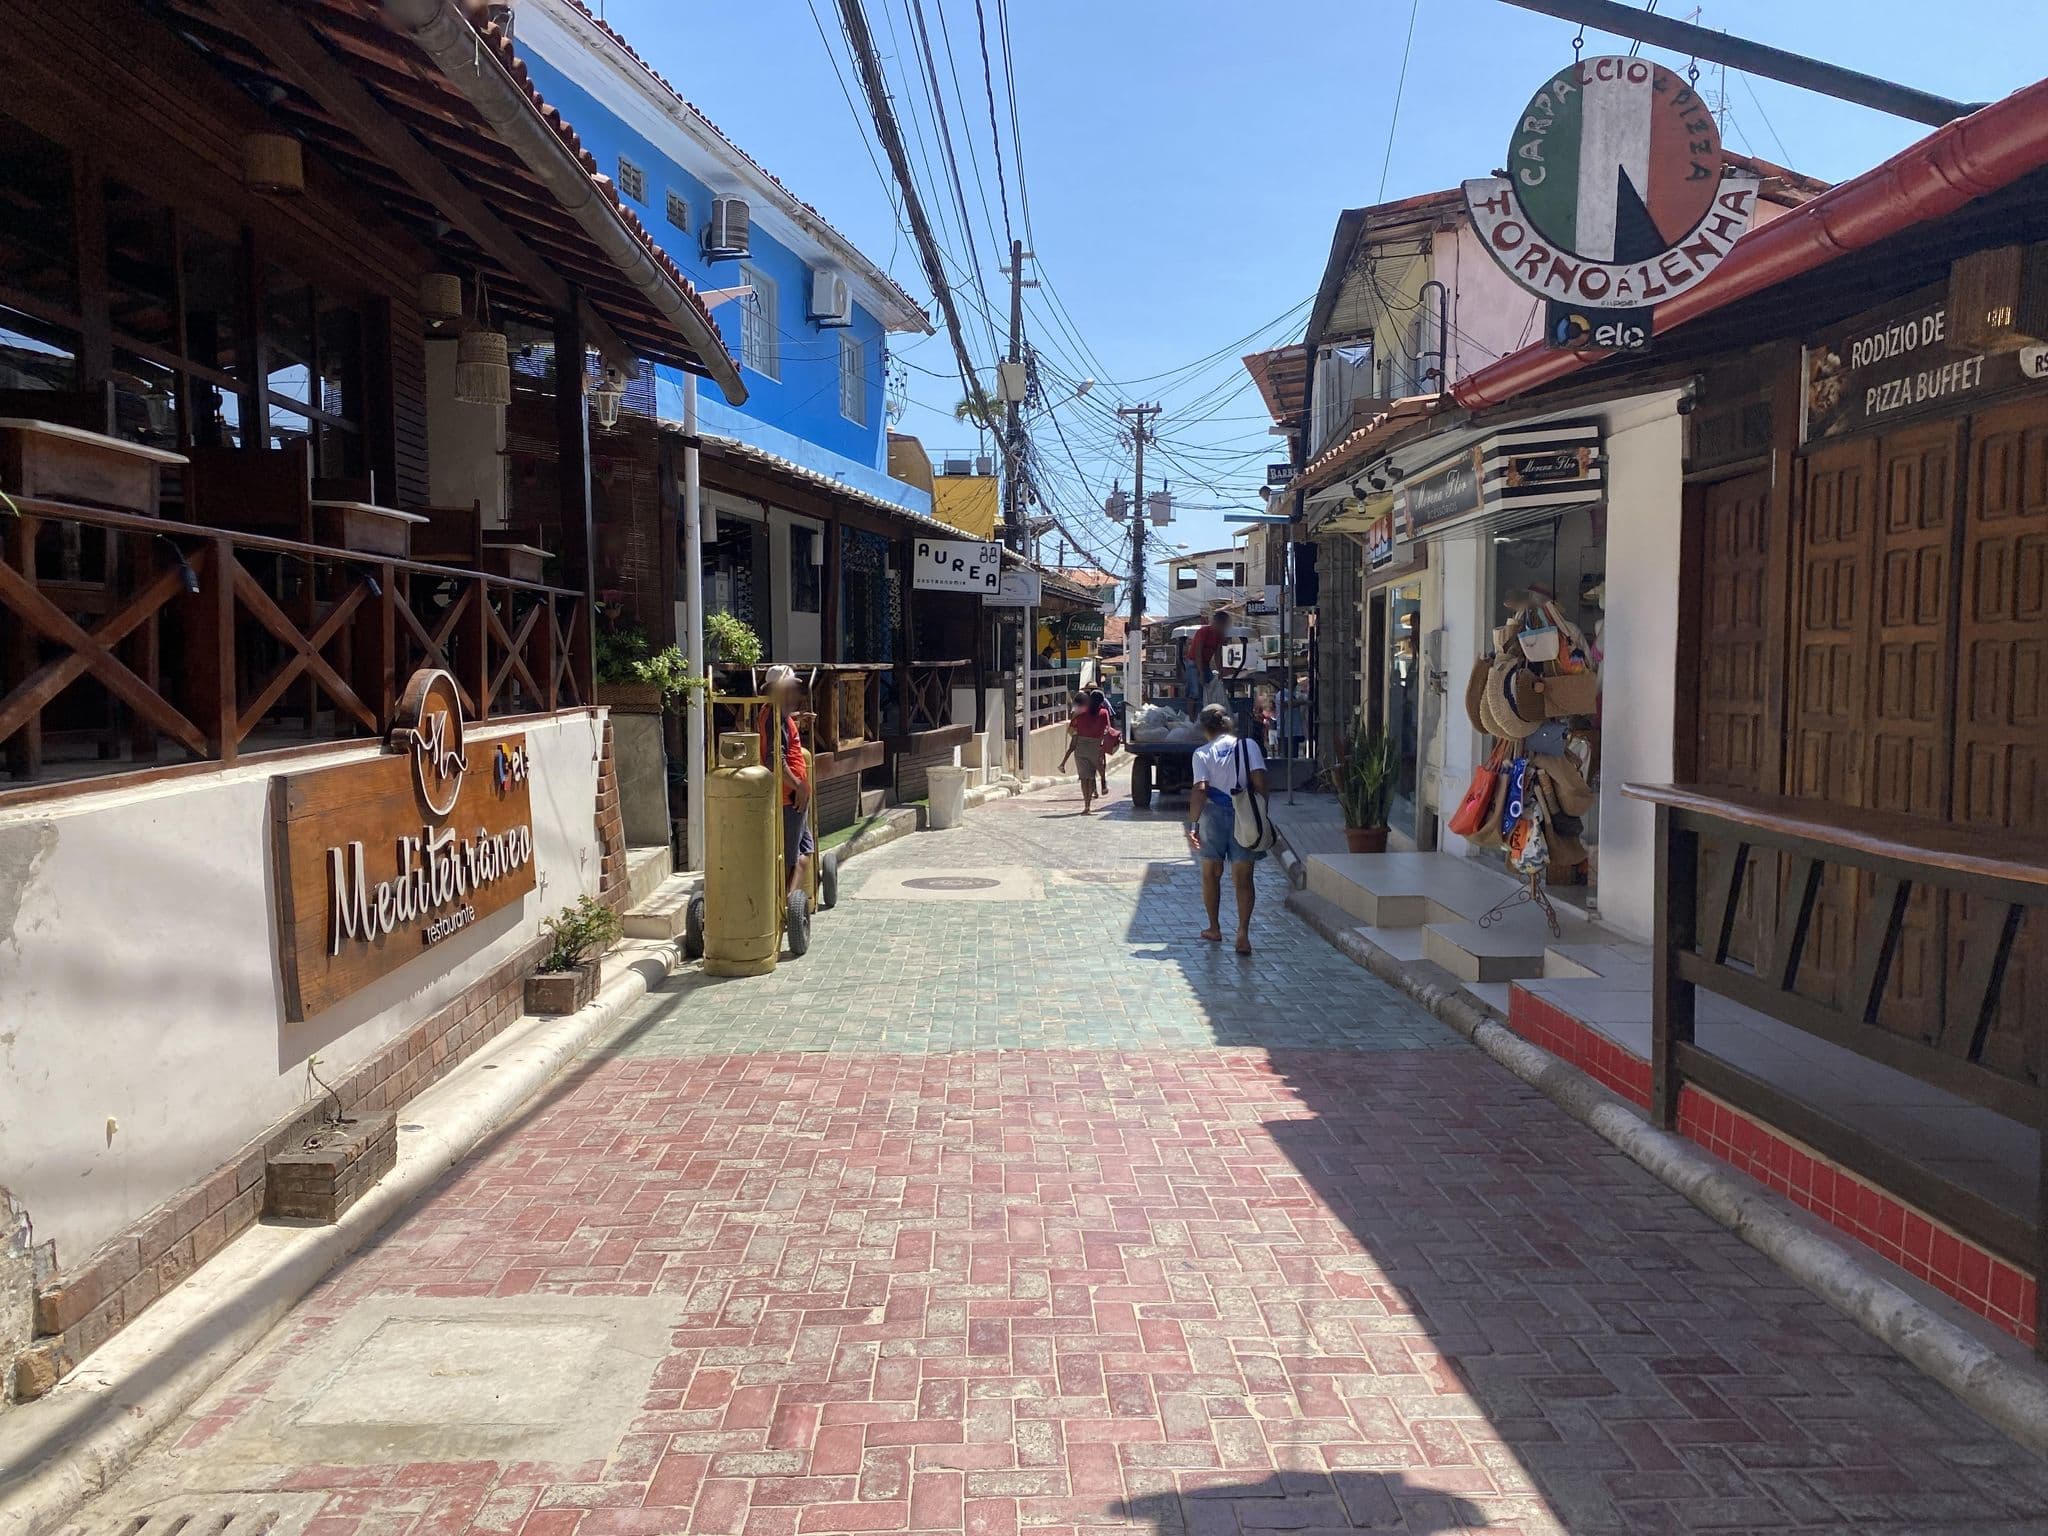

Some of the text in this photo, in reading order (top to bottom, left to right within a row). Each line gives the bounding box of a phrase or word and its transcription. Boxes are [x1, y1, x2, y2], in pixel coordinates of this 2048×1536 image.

[1520, 58, 1649, 186] CARPACCIO
[1670, 88, 1712, 181] PIZZA
[1473, 189, 1611, 300] FORNO
[1642, 189, 1753, 299] LENHA
[1595, 325, 1645, 348] elo
[1851, 310, 1945, 371] RODÍZIO DE
[1865, 355, 1985, 416] PIZZA BUFFET
[918, 543, 997, 587] AUREA
[332, 824, 533, 957] Mediterrâneo
[426, 903, 475, 946] restaurante
